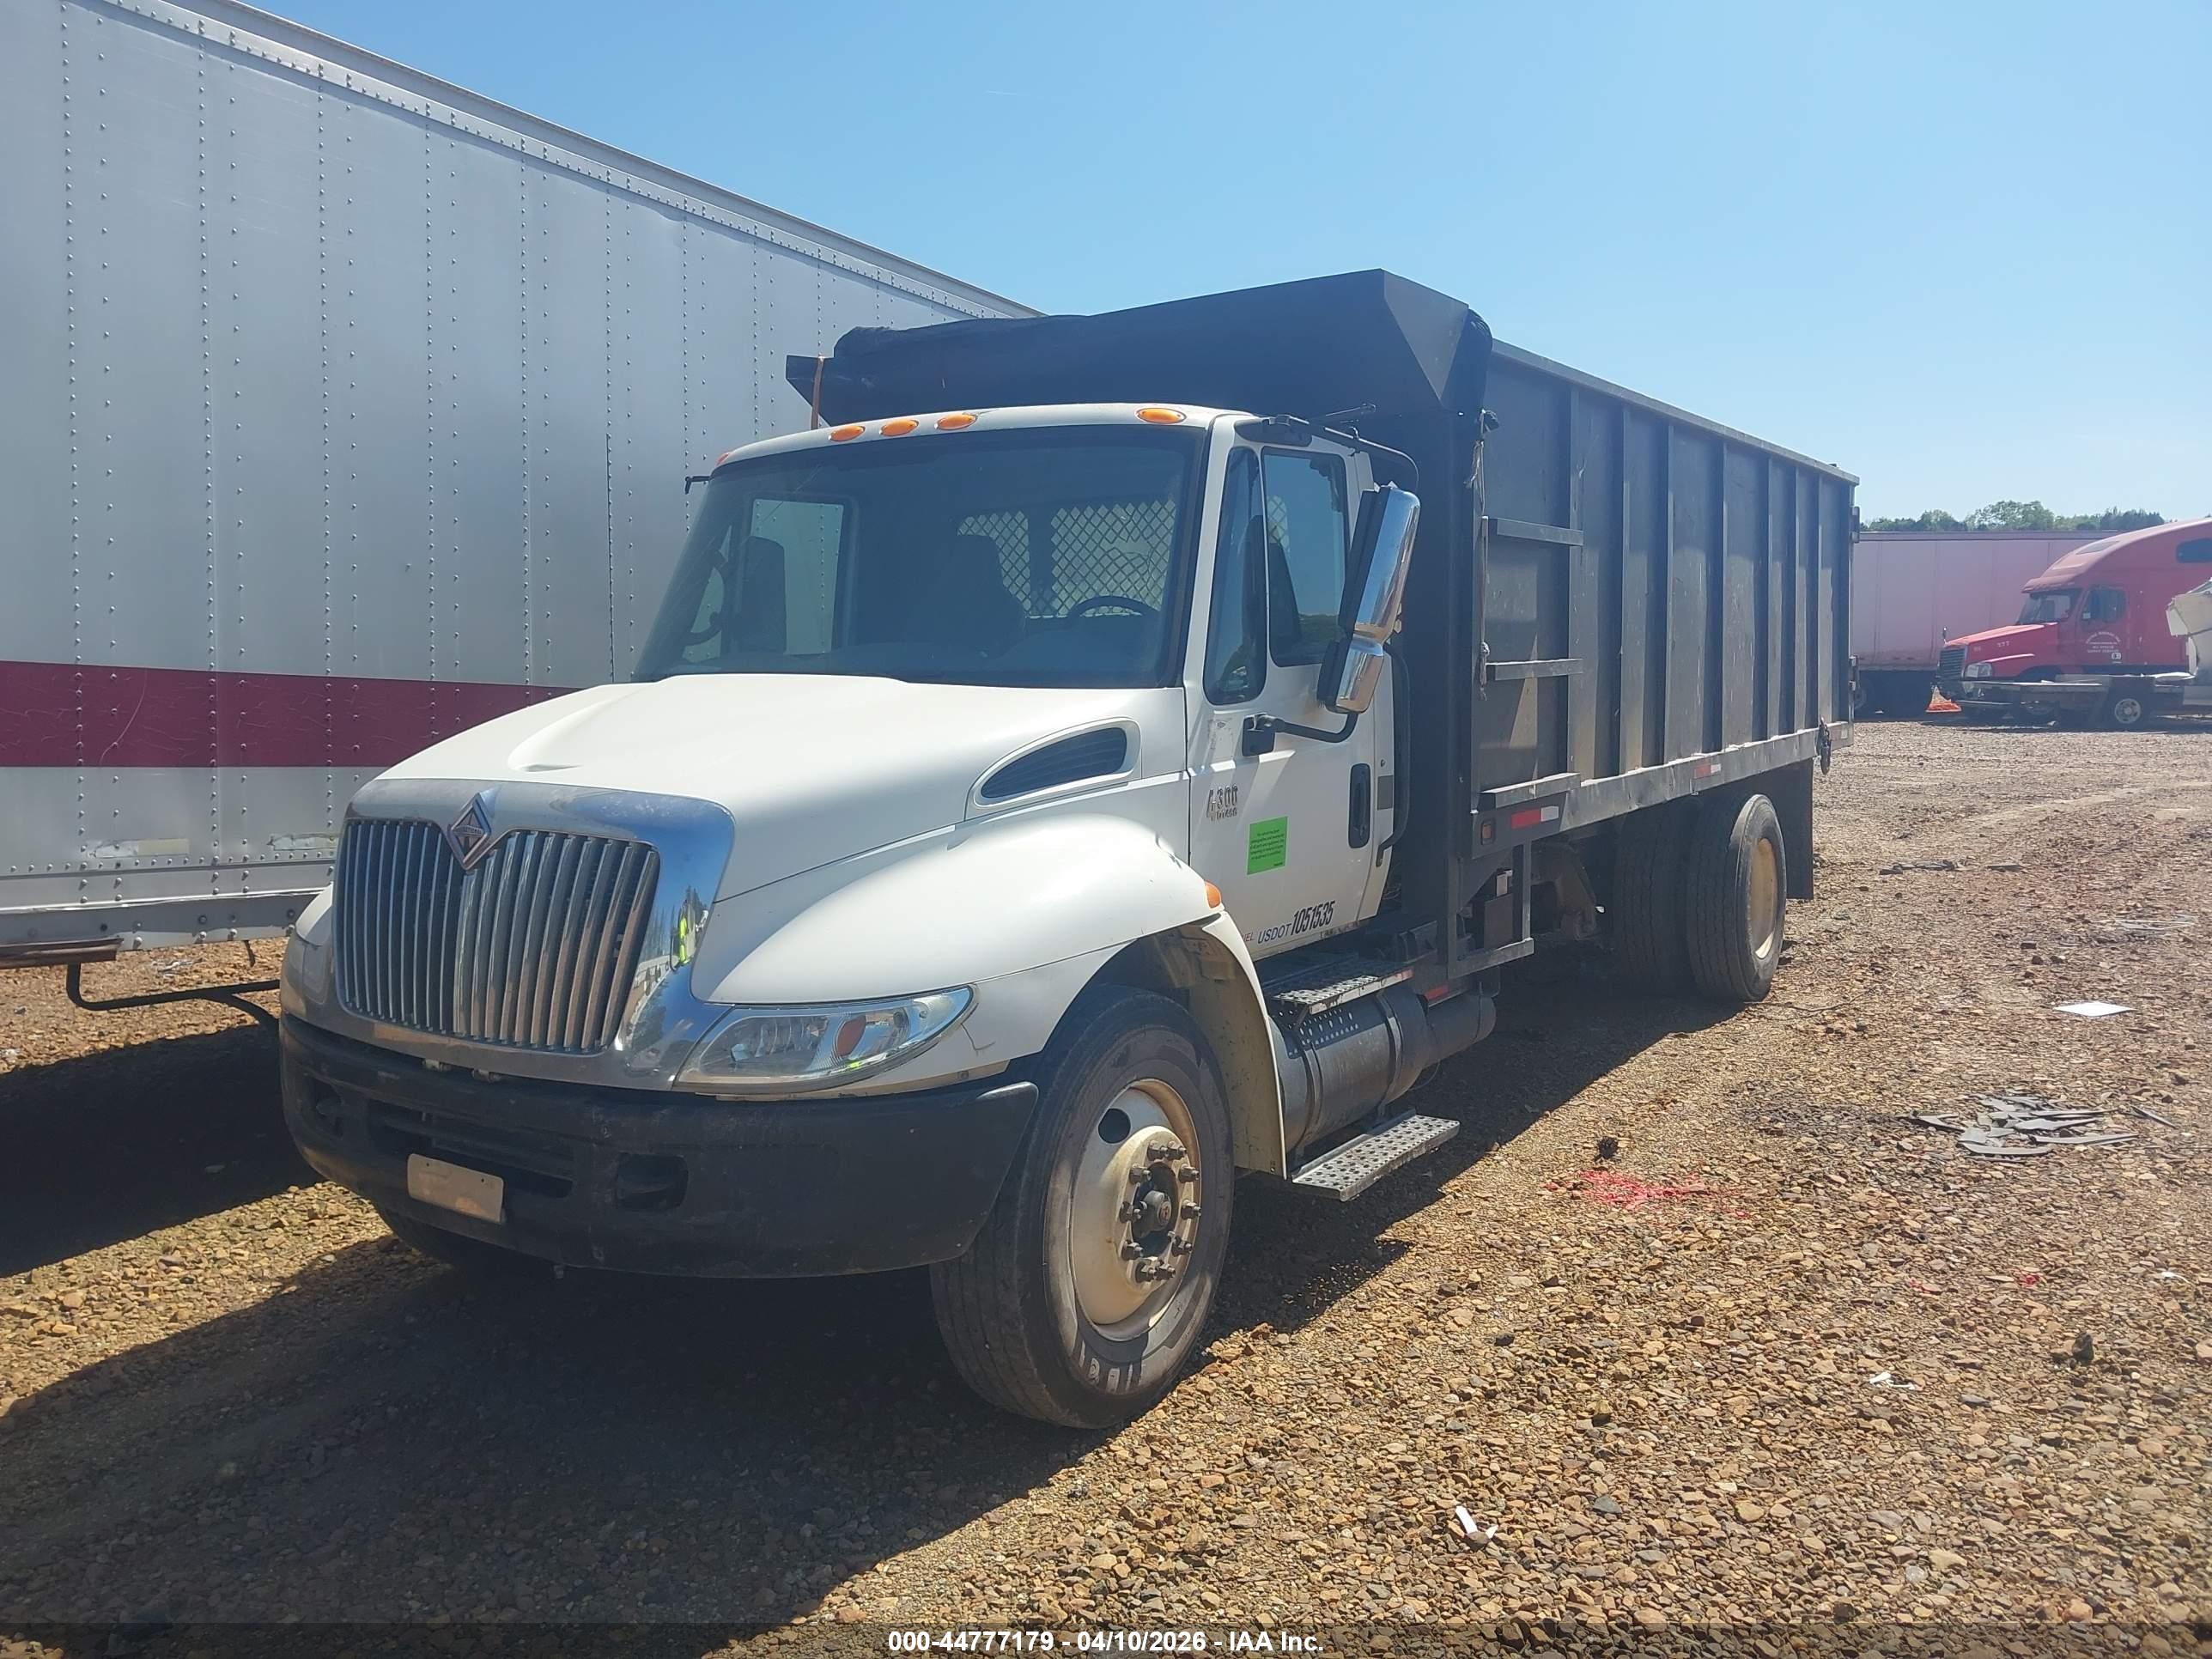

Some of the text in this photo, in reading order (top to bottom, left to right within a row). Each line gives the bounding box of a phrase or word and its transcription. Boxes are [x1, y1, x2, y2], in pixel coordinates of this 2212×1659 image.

[1206, 785, 1238, 820] 4300
[1257, 922, 1291, 944] USDOT
[1291, 900, 1335, 935] 1051535
